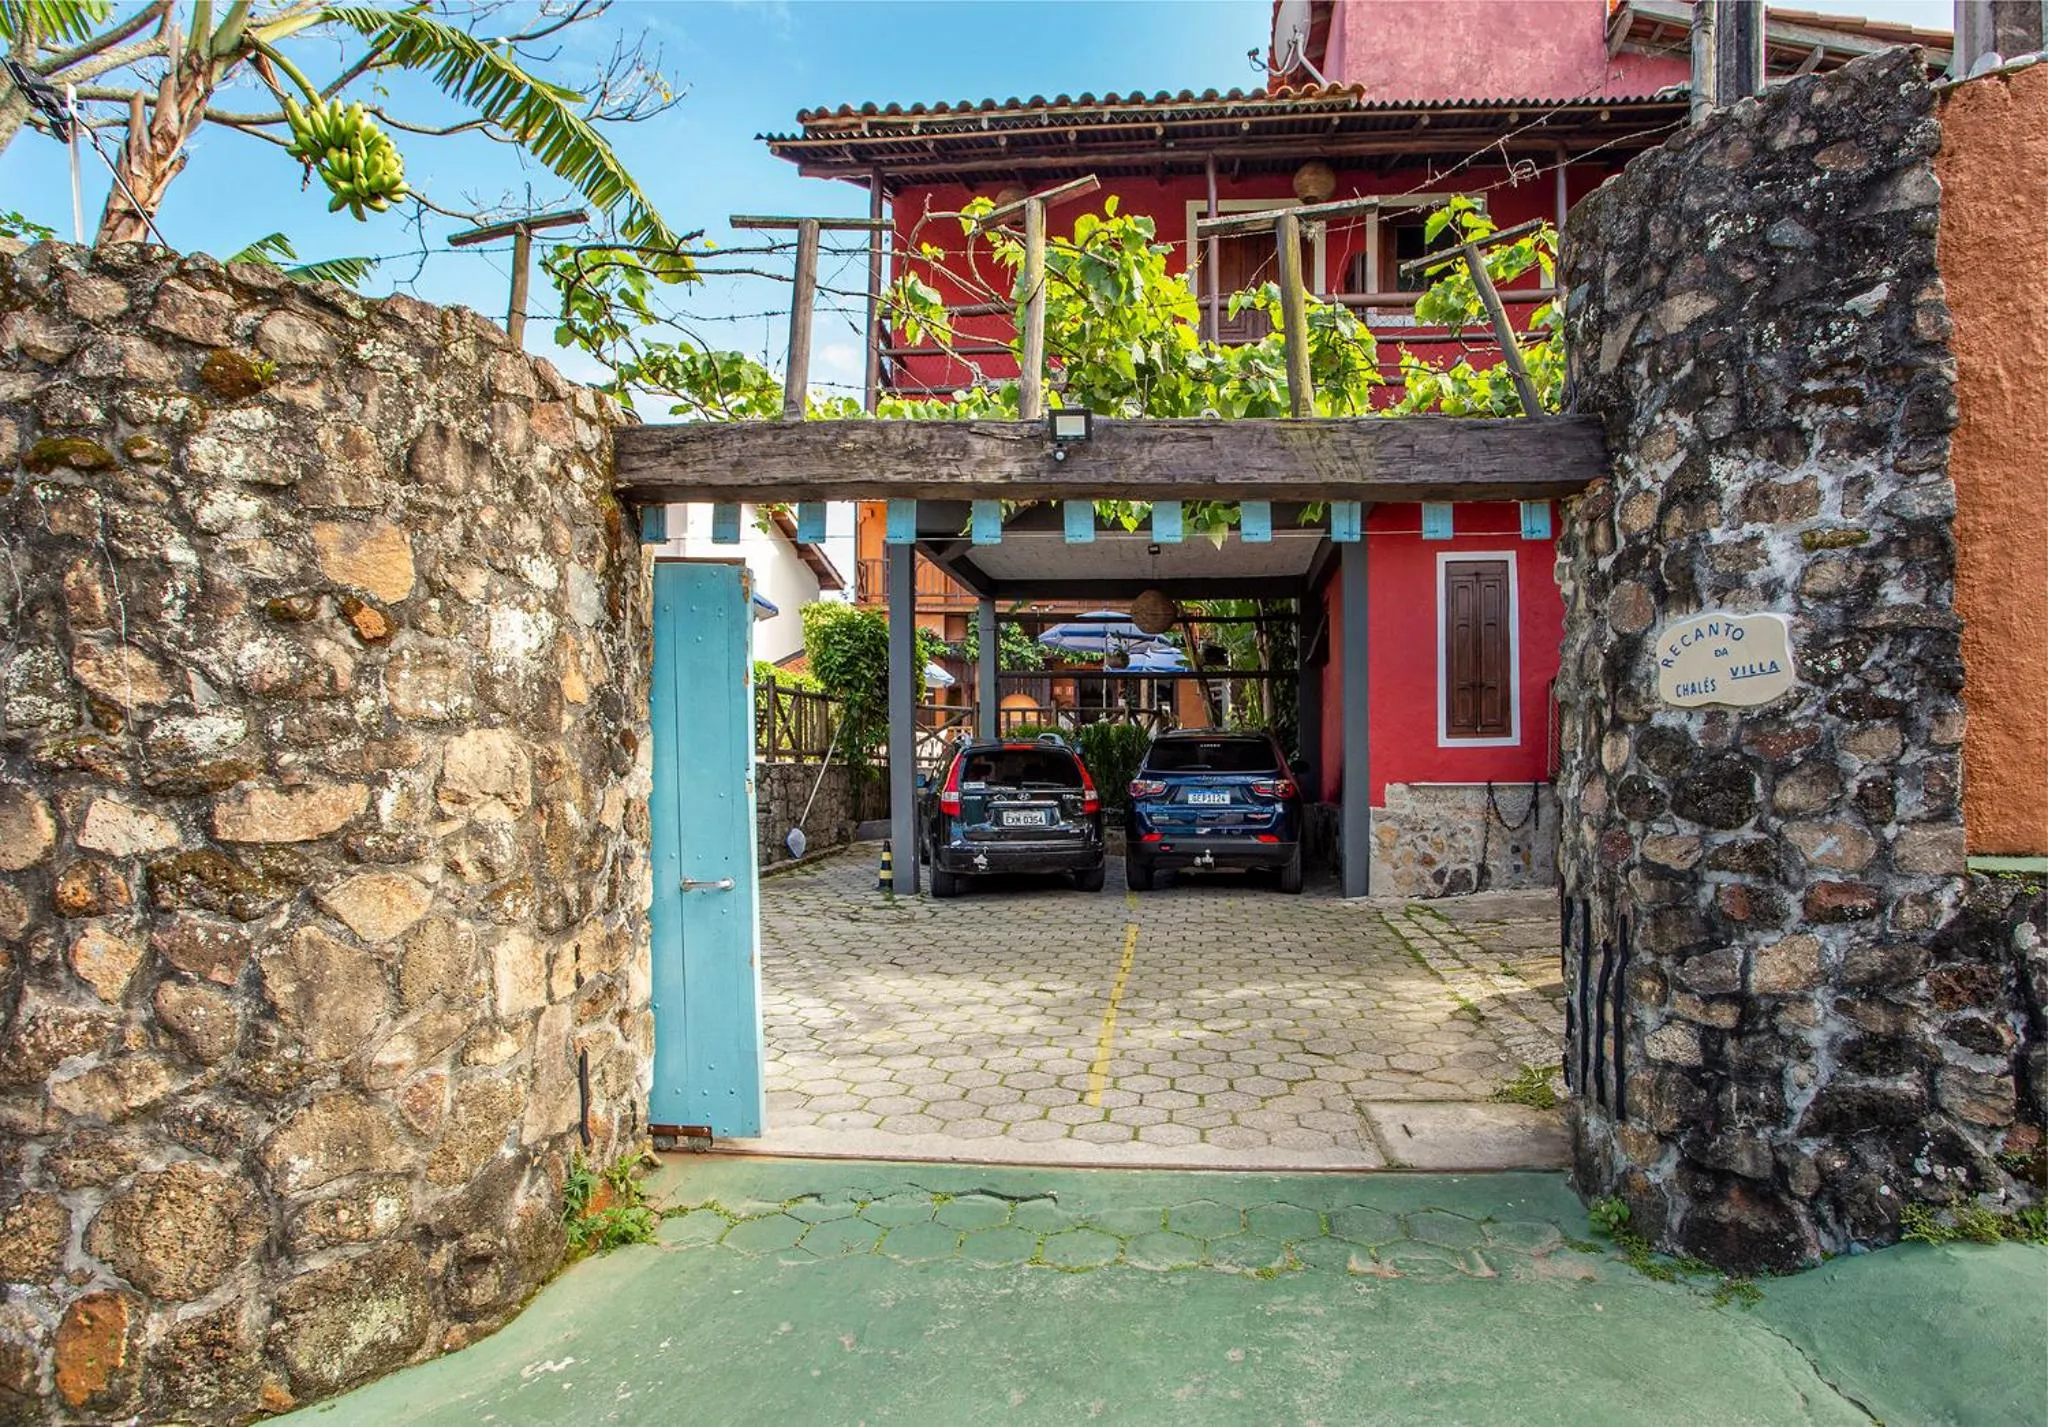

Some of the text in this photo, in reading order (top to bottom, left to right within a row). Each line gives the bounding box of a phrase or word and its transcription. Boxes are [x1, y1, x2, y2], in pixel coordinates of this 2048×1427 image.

[1661, 622, 1744, 668] RECANTO
[1714, 647, 1729, 658] DA
[1730, 660, 1780, 677] VILLA
[1675, 677, 1716, 698] CHALÉS
